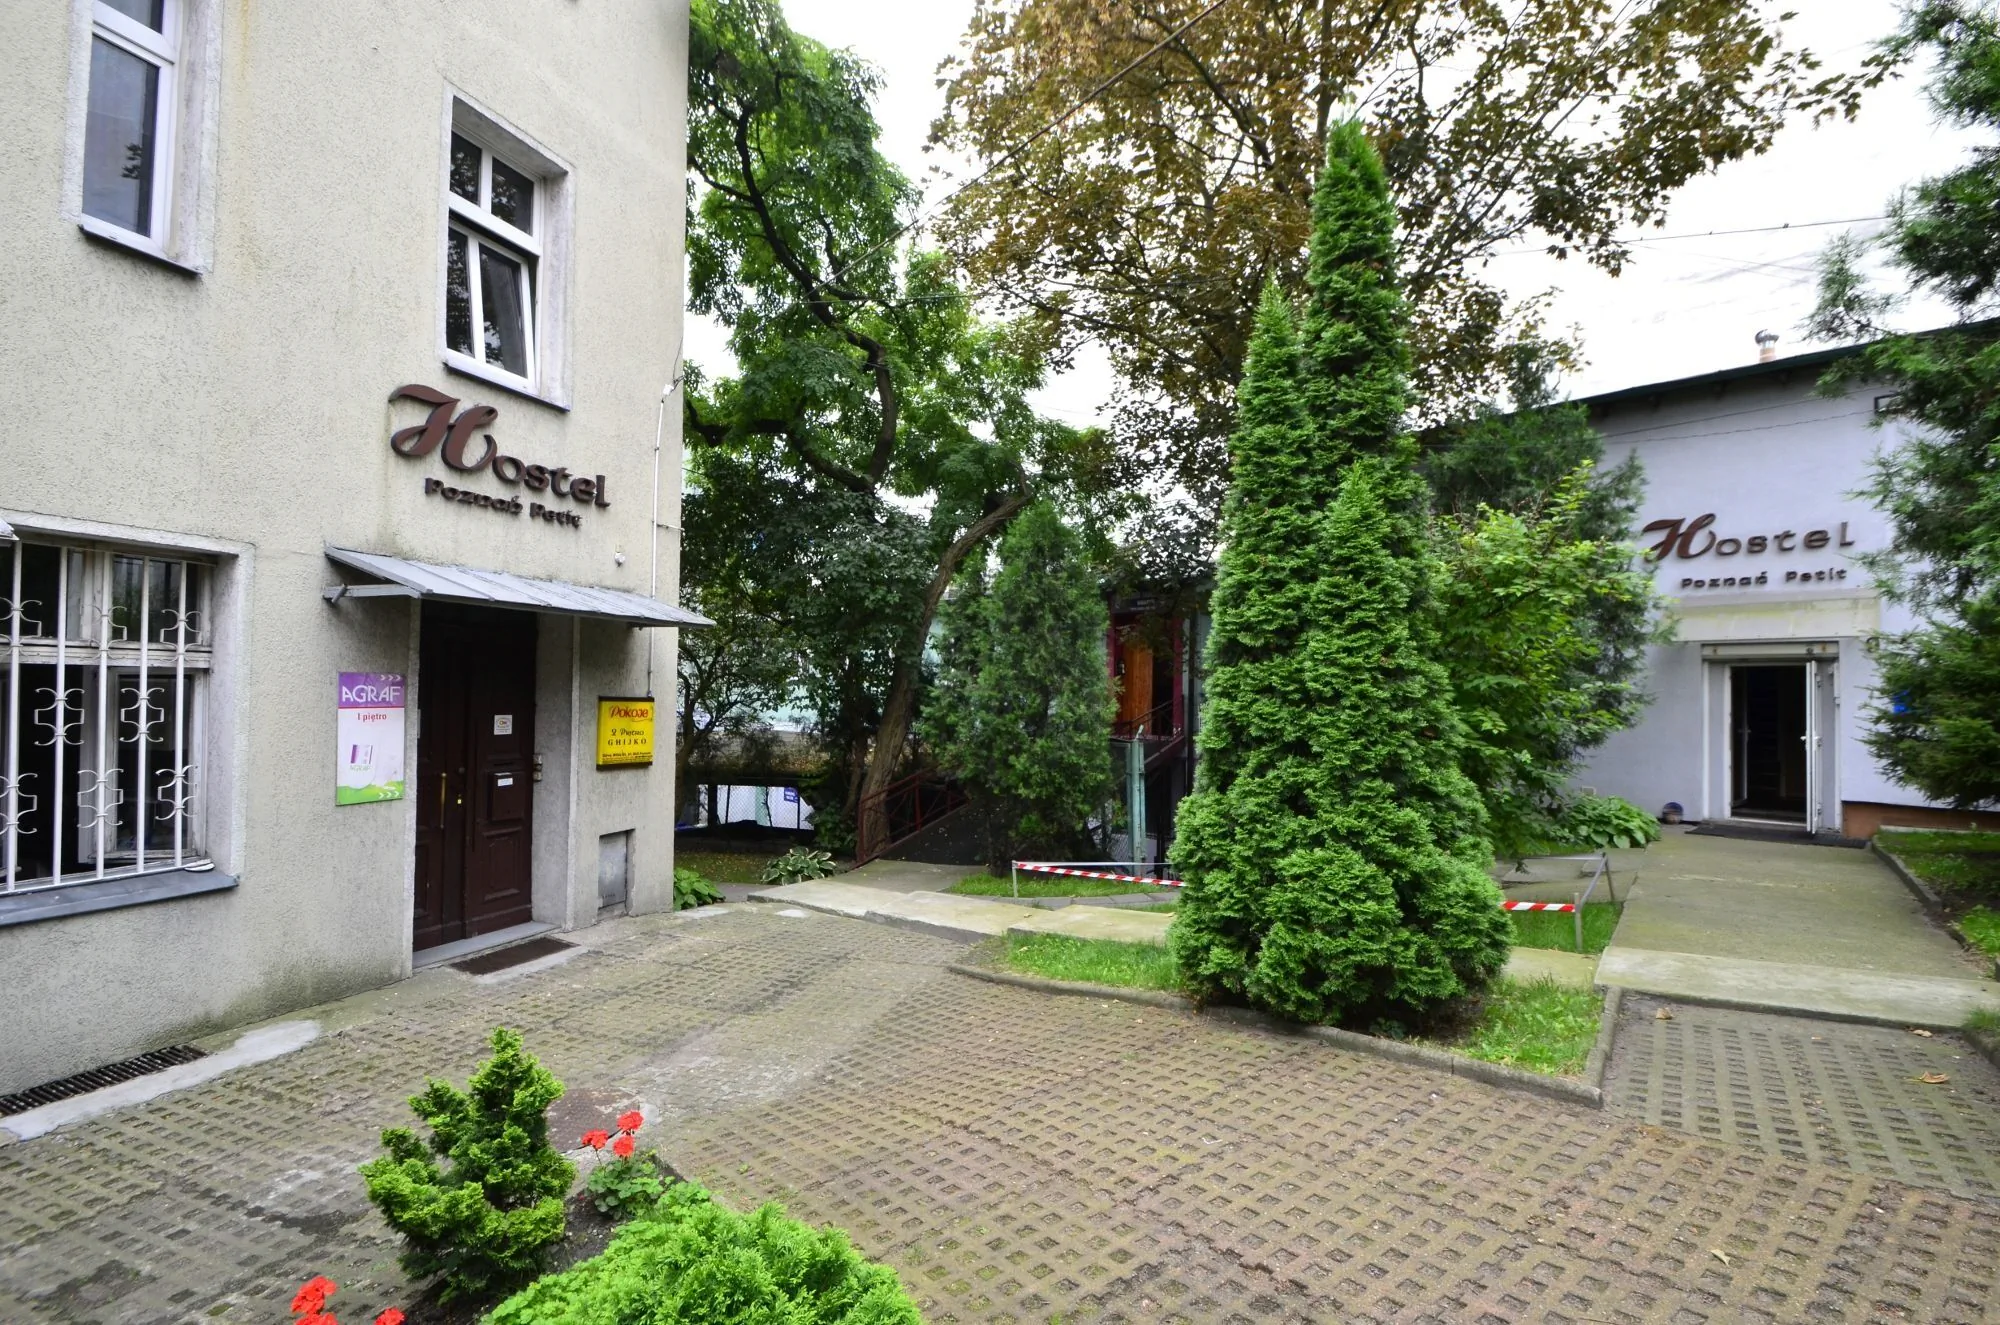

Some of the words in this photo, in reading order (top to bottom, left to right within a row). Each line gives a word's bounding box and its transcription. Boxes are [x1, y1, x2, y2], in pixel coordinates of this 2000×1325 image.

[388, 383, 611, 508] Hostel
[529, 501, 582, 529] Petit
[1641, 512, 1855, 563] Hostel
[1681, 571, 1768, 589] Poznań
[1785, 567, 1847, 583] Petit
[342, 685, 401, 703] AGRAF
[362, 713, 387, 722] piętro
